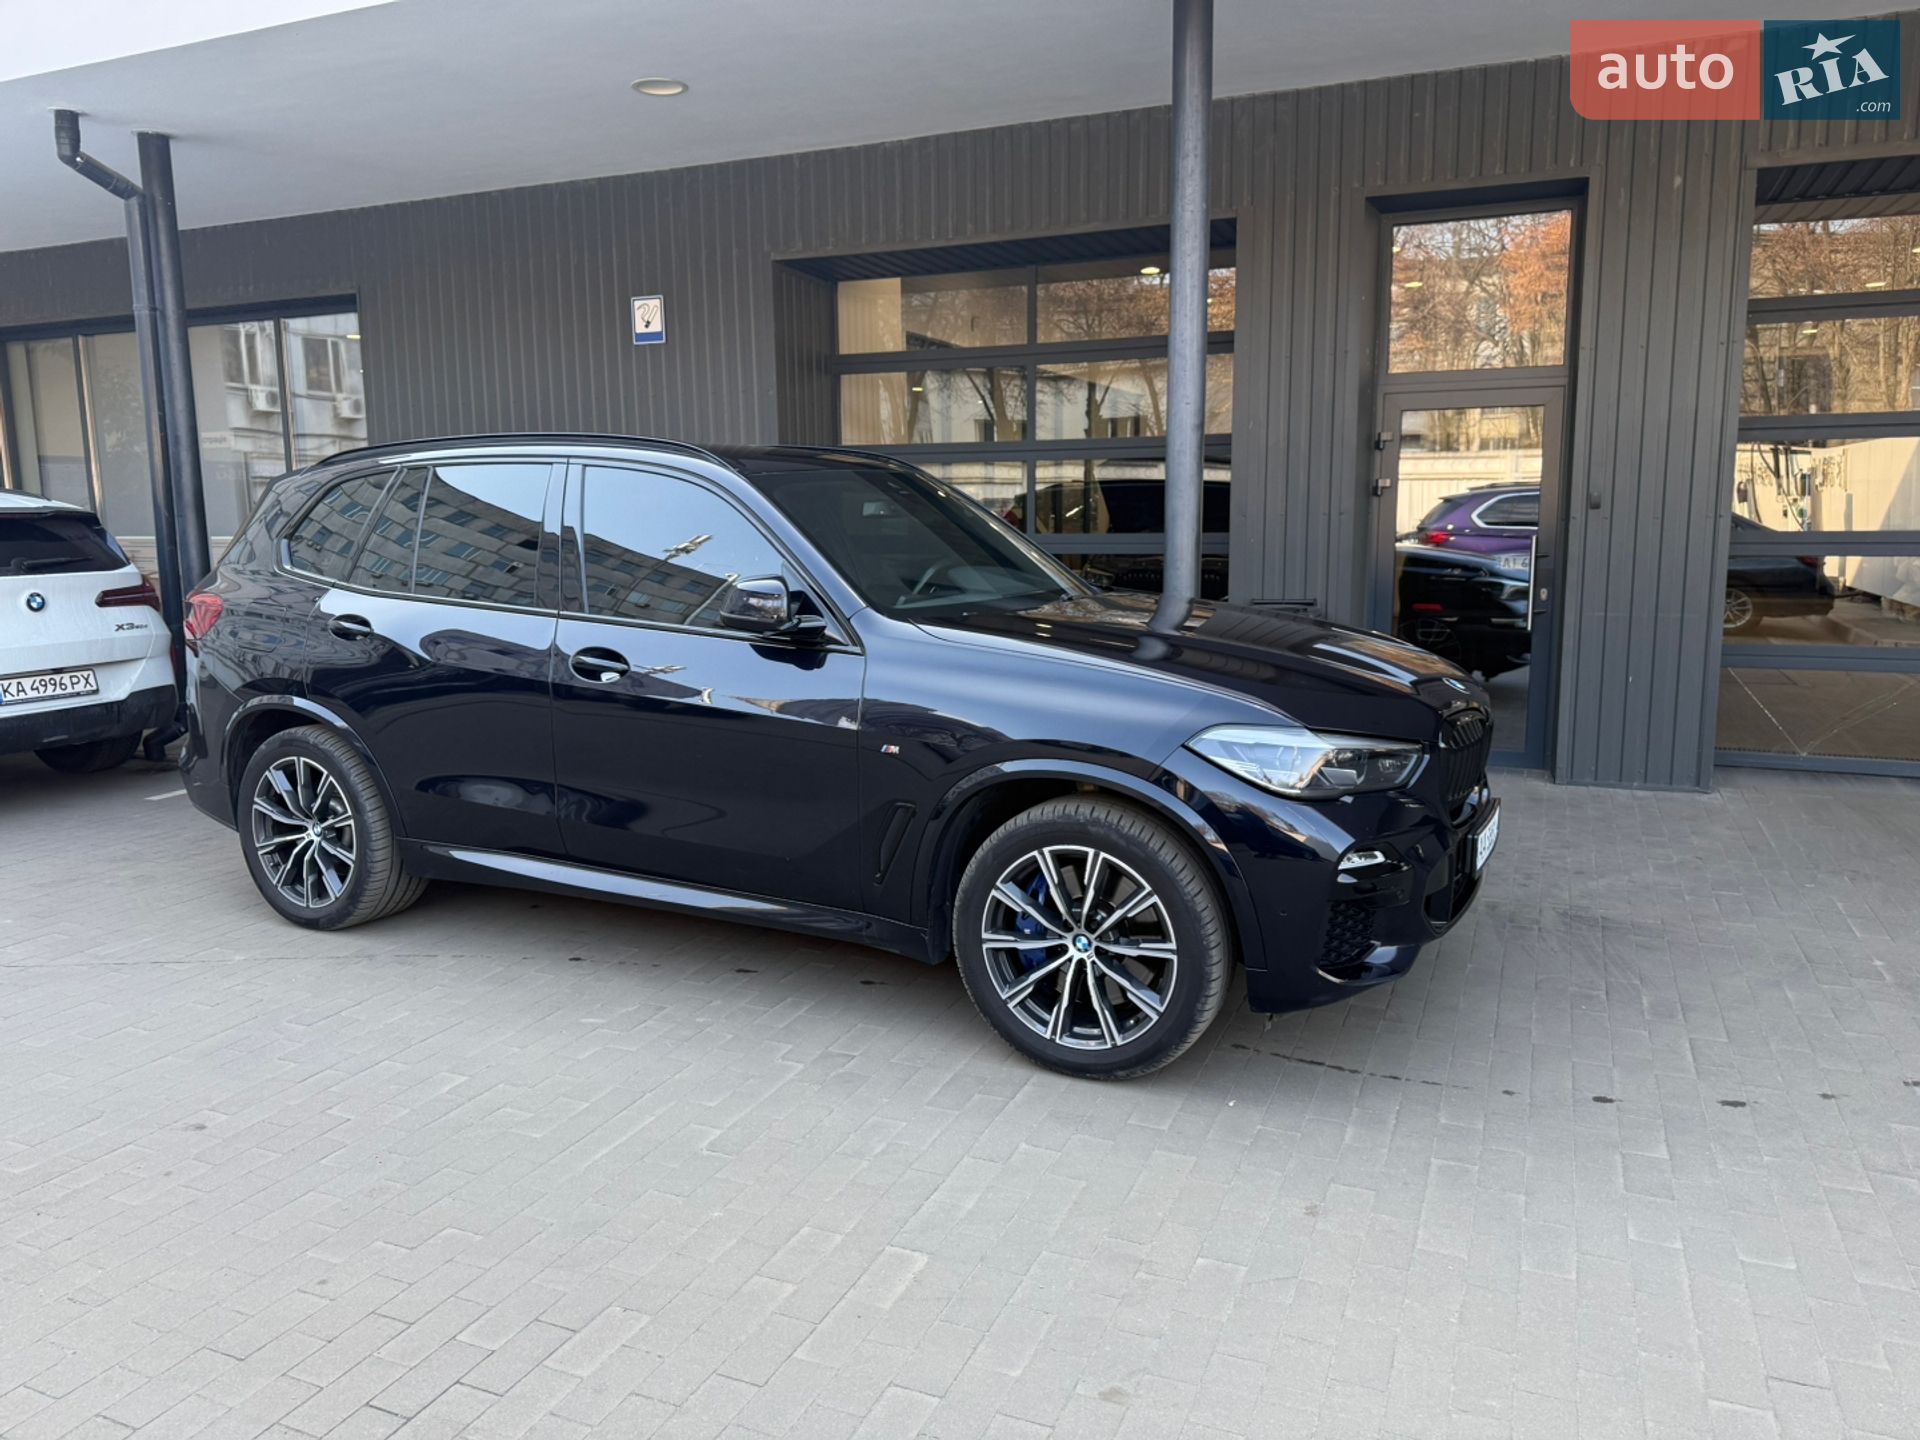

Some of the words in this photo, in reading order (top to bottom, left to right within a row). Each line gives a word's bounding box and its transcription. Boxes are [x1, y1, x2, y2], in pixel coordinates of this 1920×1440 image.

[1, 681, 28, 698] KA
[30, 676, 68, 694] 4996
[69, 673, 94, 690] PX
